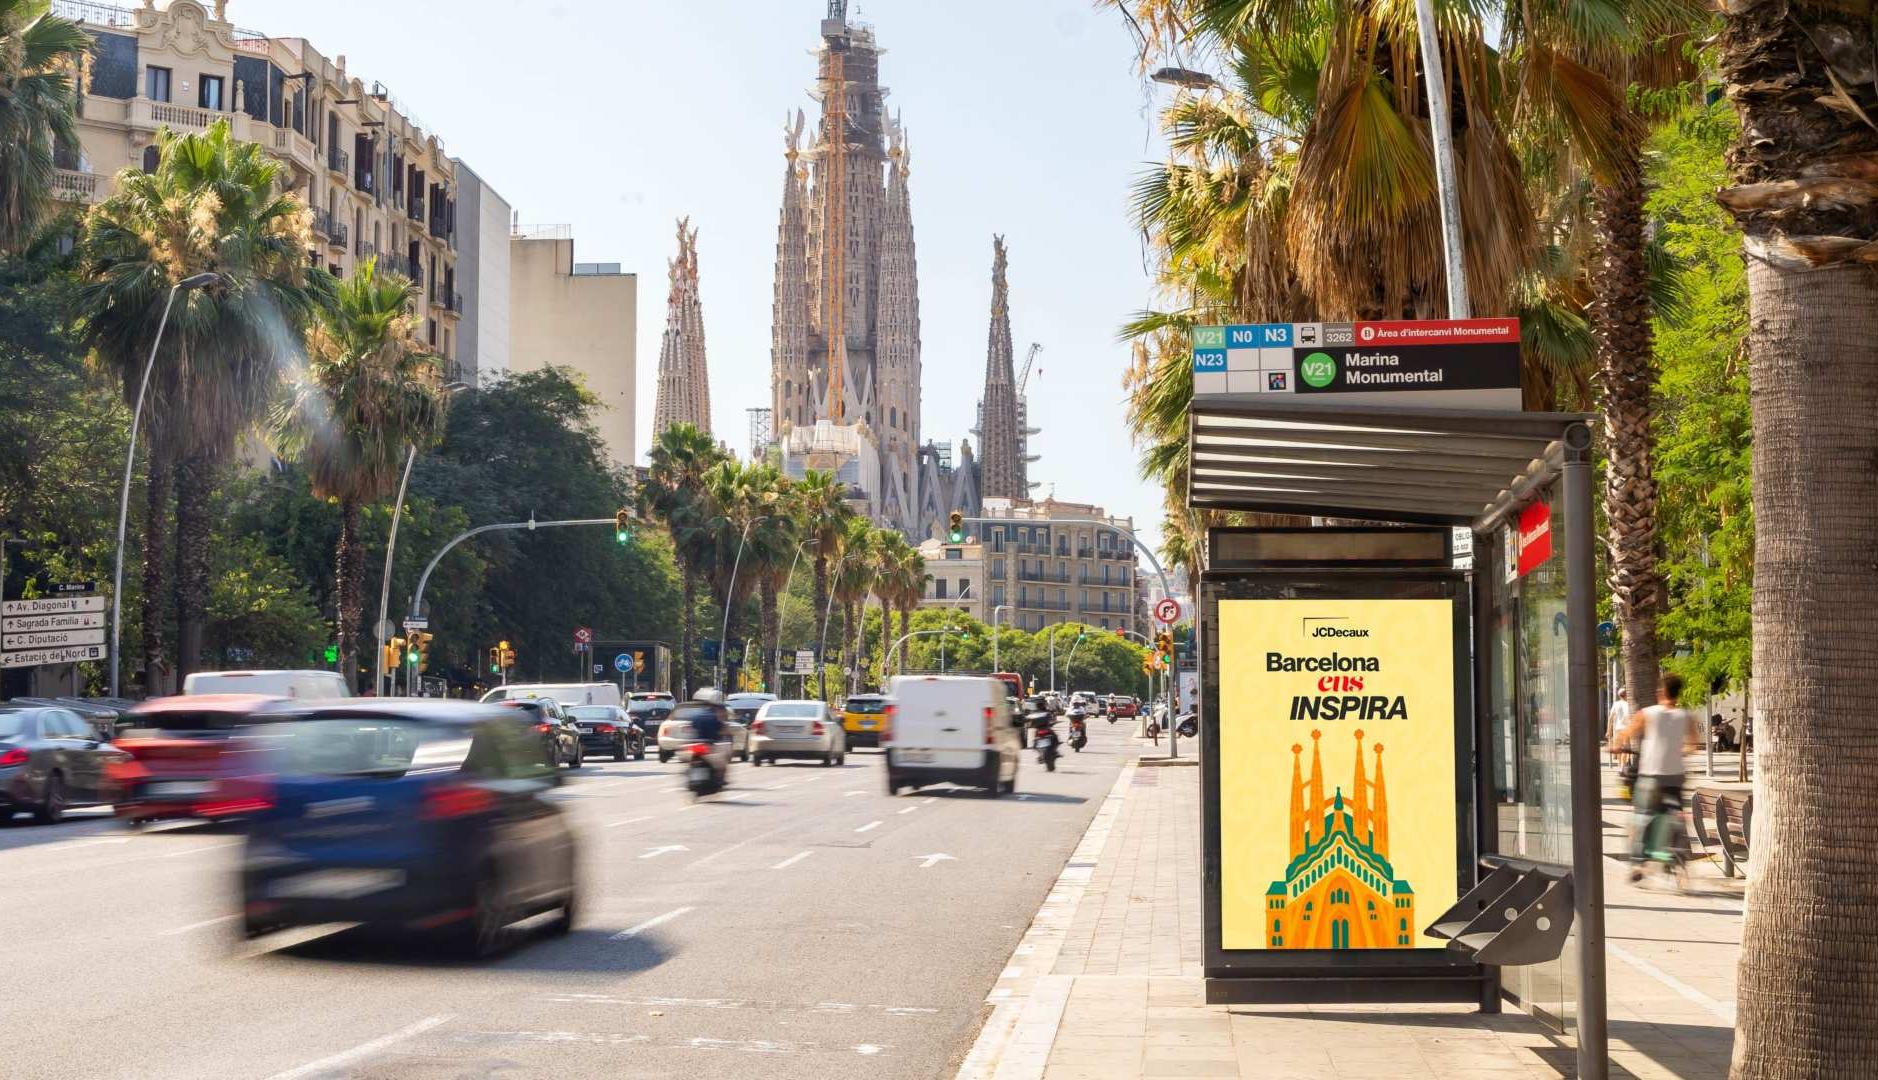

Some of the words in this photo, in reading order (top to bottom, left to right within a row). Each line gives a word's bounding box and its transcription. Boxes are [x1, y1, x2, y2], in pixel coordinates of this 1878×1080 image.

[1195, 330, 1223, 345] V21
[1232, 330, 1253, 343] N0
[1265, 328, 1287, 342] N3
[1326, 332, 1353, 343] 3262
[1453, 325, 1509, 336] Monumental
[1195, 353, 1224, 366] N23
[1345, 353, 1400, 367] Marina
[1303, 362, 1332, 376] V21
[1346, 369, 1443, 384] Monumental
[16, 602, 30, 612] Av.
[32, 600, 70, 612] Diagonal
[16, 617, 49, 629] Sagrada
[17, 635, 27, 645] C.
[28, 632, 68, 645] Diputació
[1312, 626, 1370, 638] JCDecaux
[14, 651, 47, 663] Estació
[65, 647, 86, 659] Nord
[1266, 652, 1380, 672] Barcelona
[1317, 675, 1364, 692] ens
[1289, 695, 1408, 720] INSPIRA
